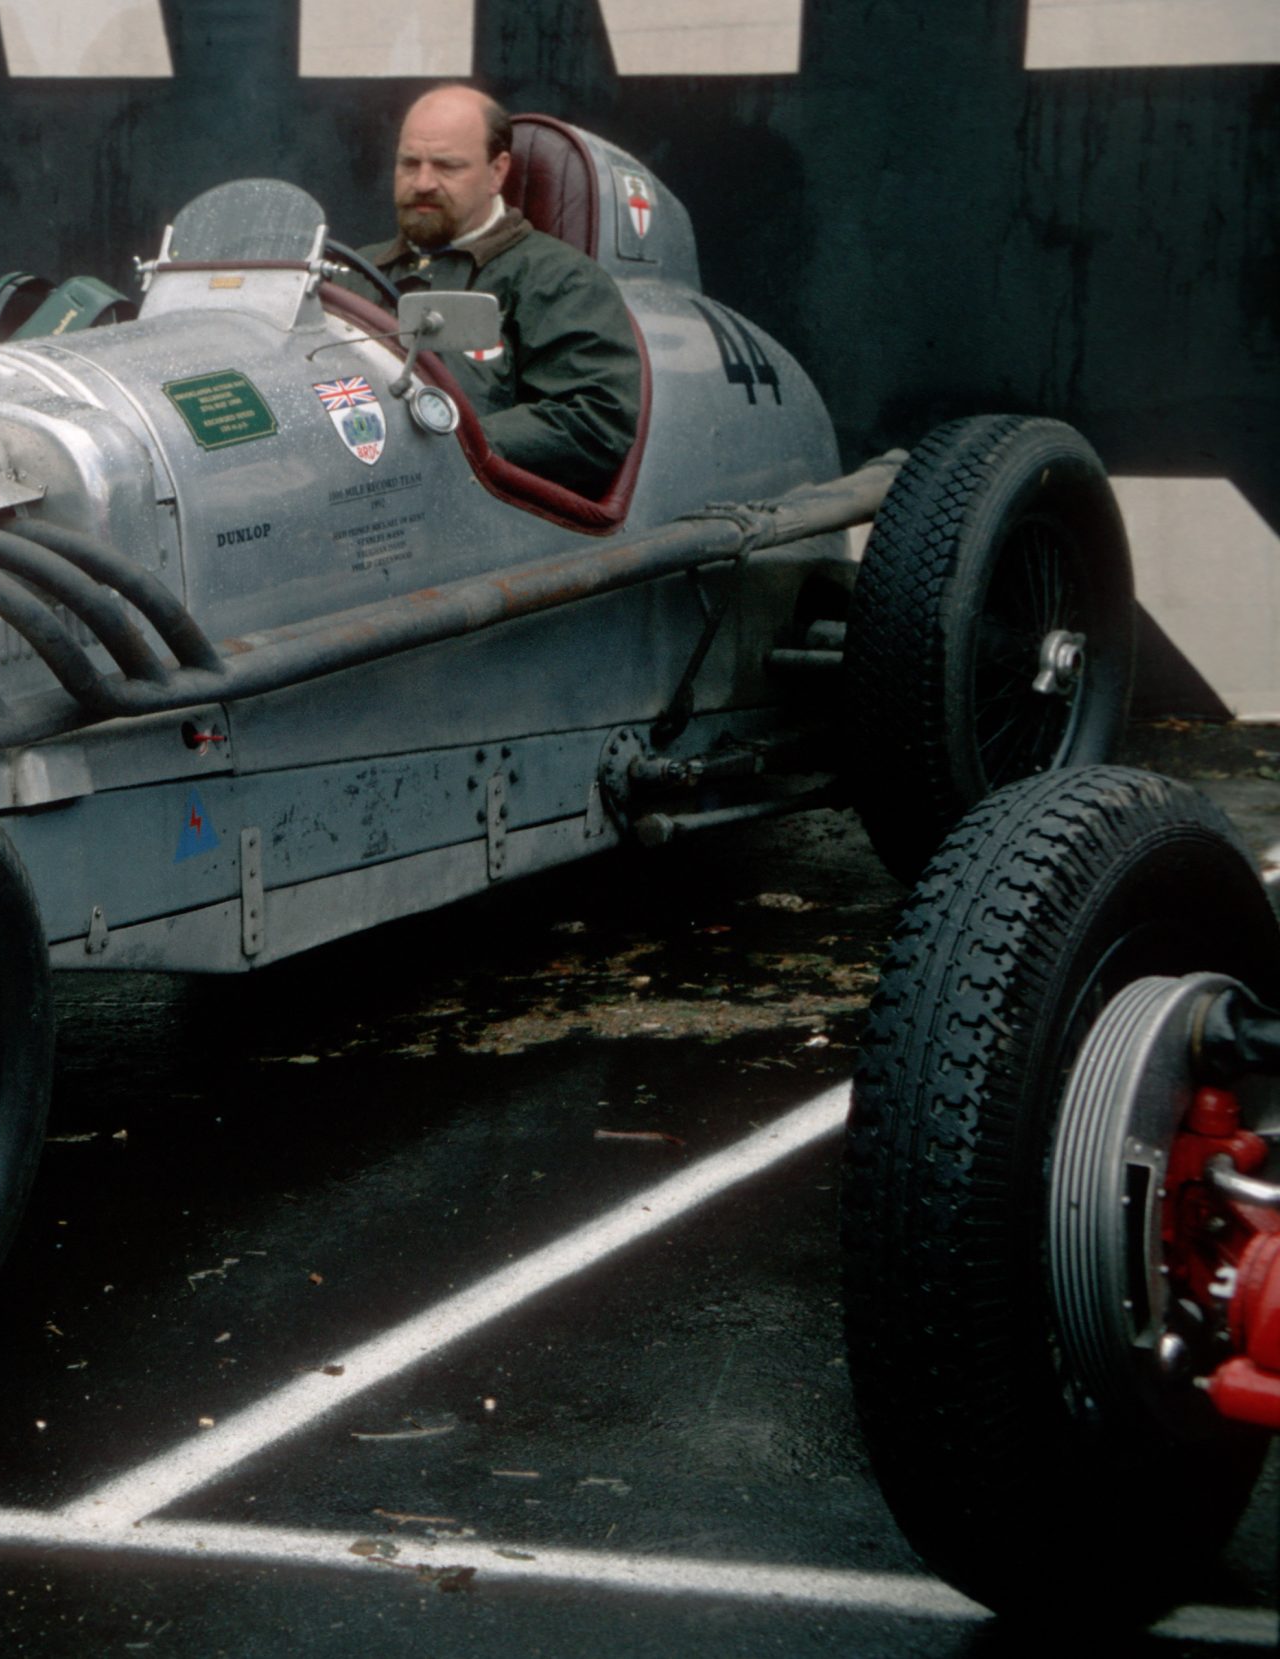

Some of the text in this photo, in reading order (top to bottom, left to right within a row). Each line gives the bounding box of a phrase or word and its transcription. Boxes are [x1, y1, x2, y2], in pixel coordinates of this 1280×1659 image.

[686, 299, 782, 406] 44
[356, 443, 380, 460] BRDC
[365, 477, 399, 493] RECORD
[400, 472, 422, 487] TEAM
[217, 523, 271, 548] DUNLOP
